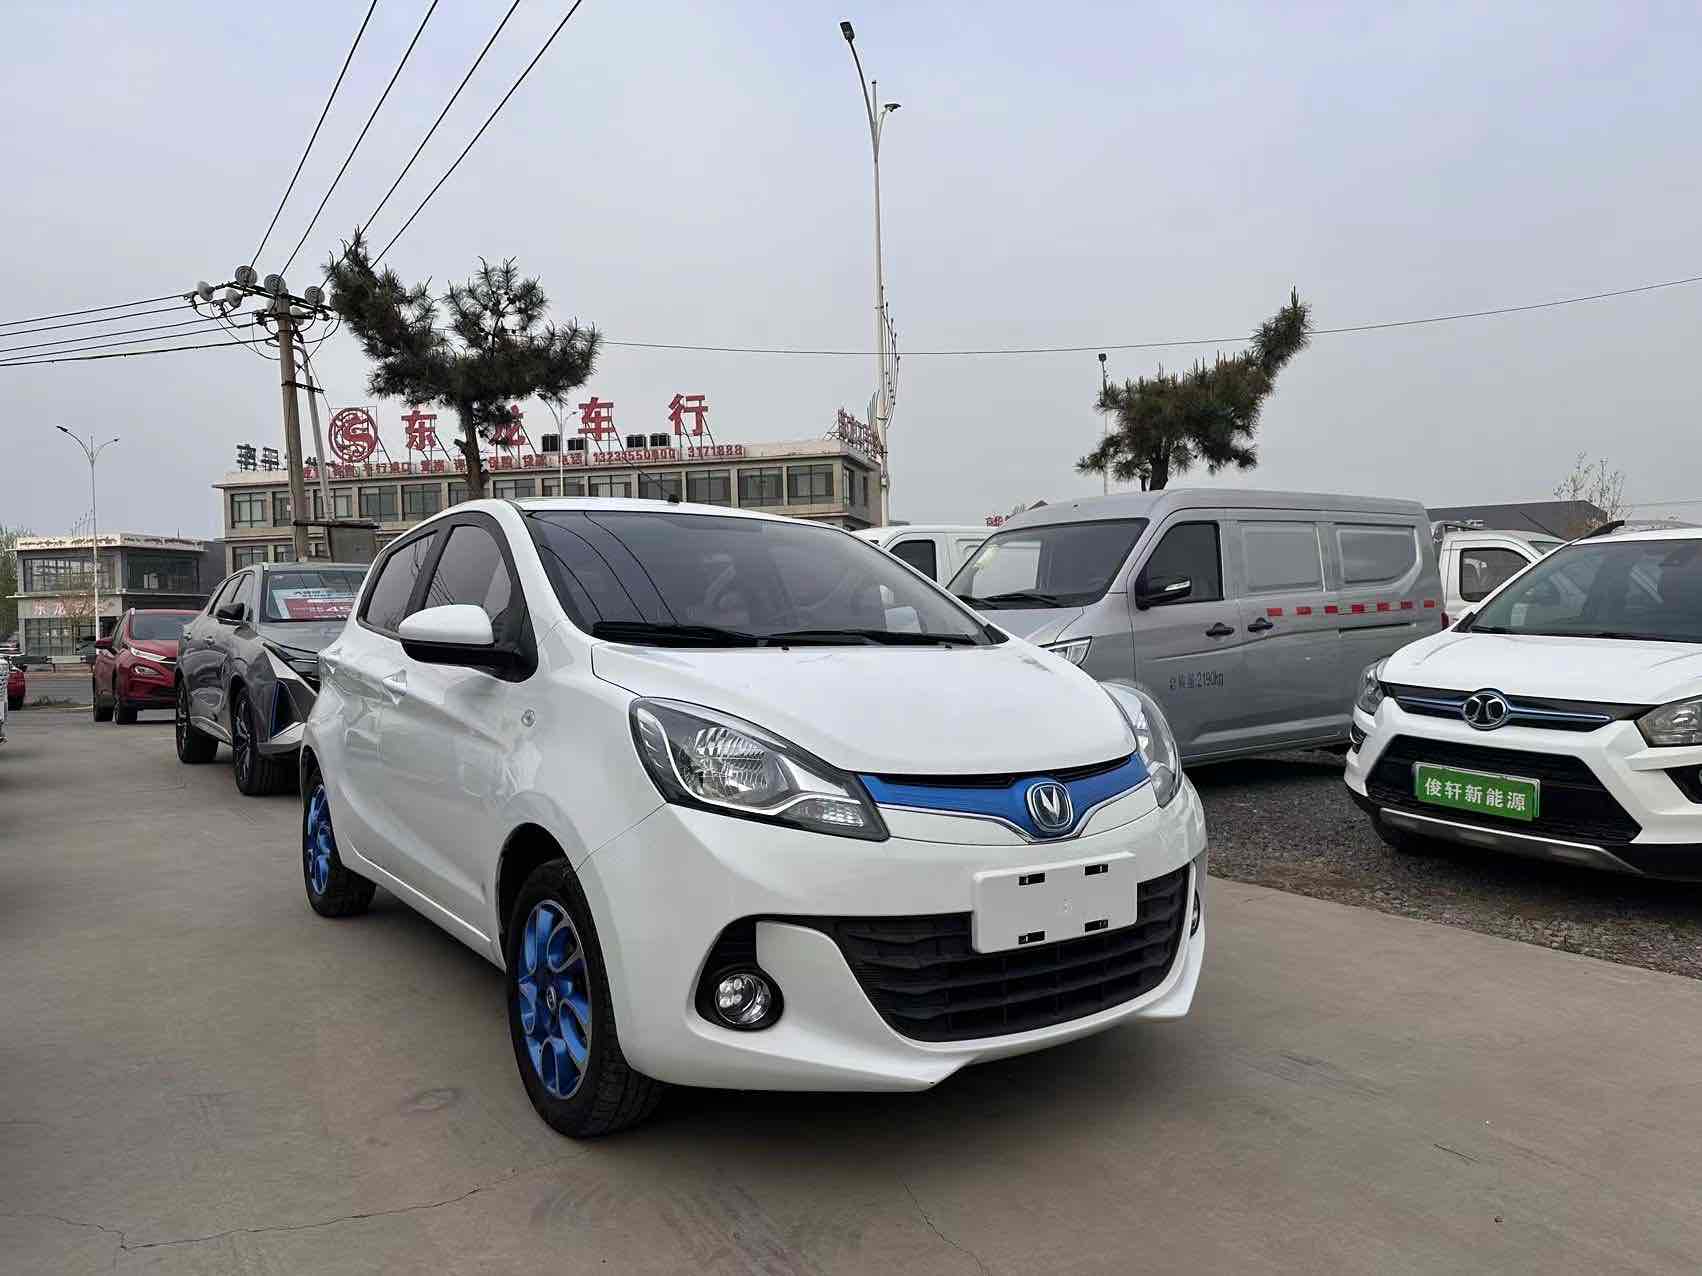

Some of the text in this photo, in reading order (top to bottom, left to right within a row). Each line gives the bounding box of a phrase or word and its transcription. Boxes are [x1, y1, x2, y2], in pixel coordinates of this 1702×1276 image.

[688, 444, 745, 458] 3171888
[1424, 777, 1526, 811] 俊轩新能源
